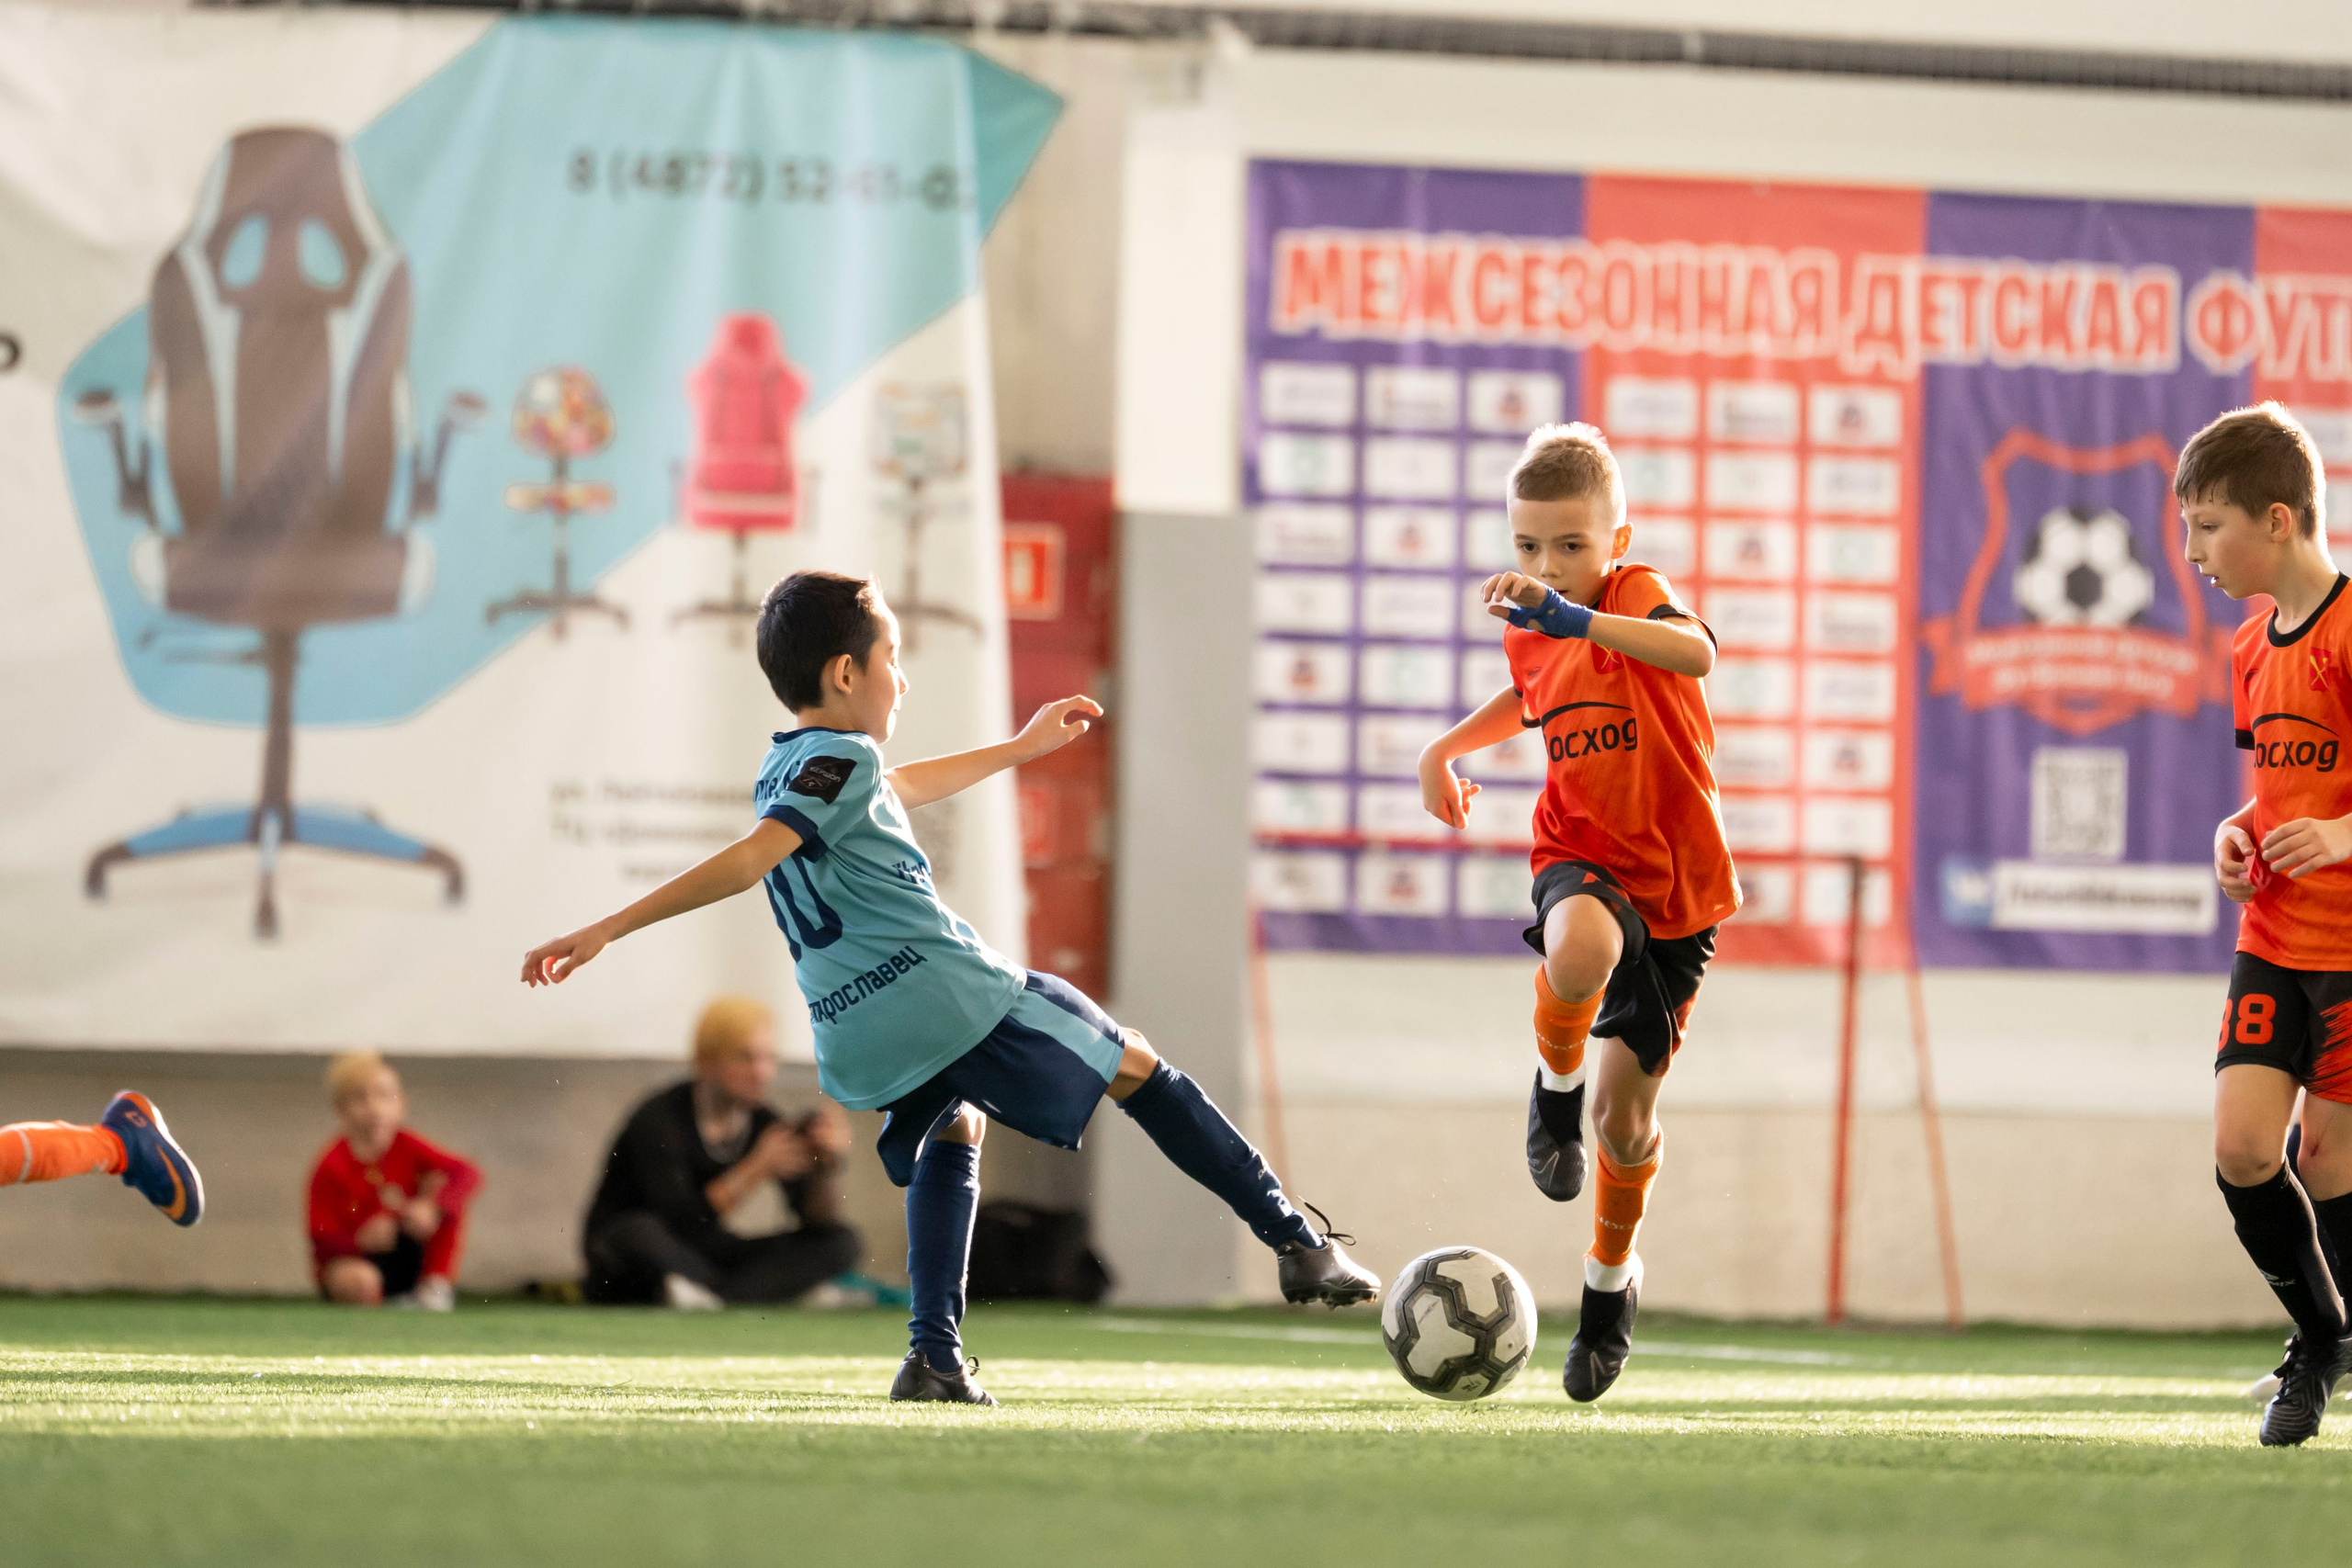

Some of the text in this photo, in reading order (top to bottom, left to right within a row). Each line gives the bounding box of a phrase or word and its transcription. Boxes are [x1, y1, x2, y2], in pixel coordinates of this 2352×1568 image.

[1273, 231, 2352, 378] МЕЖСЕЗОННАЯ ДЕТСКАЯ ФУТ
[1544, 717, 1638, 763] осход
[2254, 740, 2339, 773] осход
